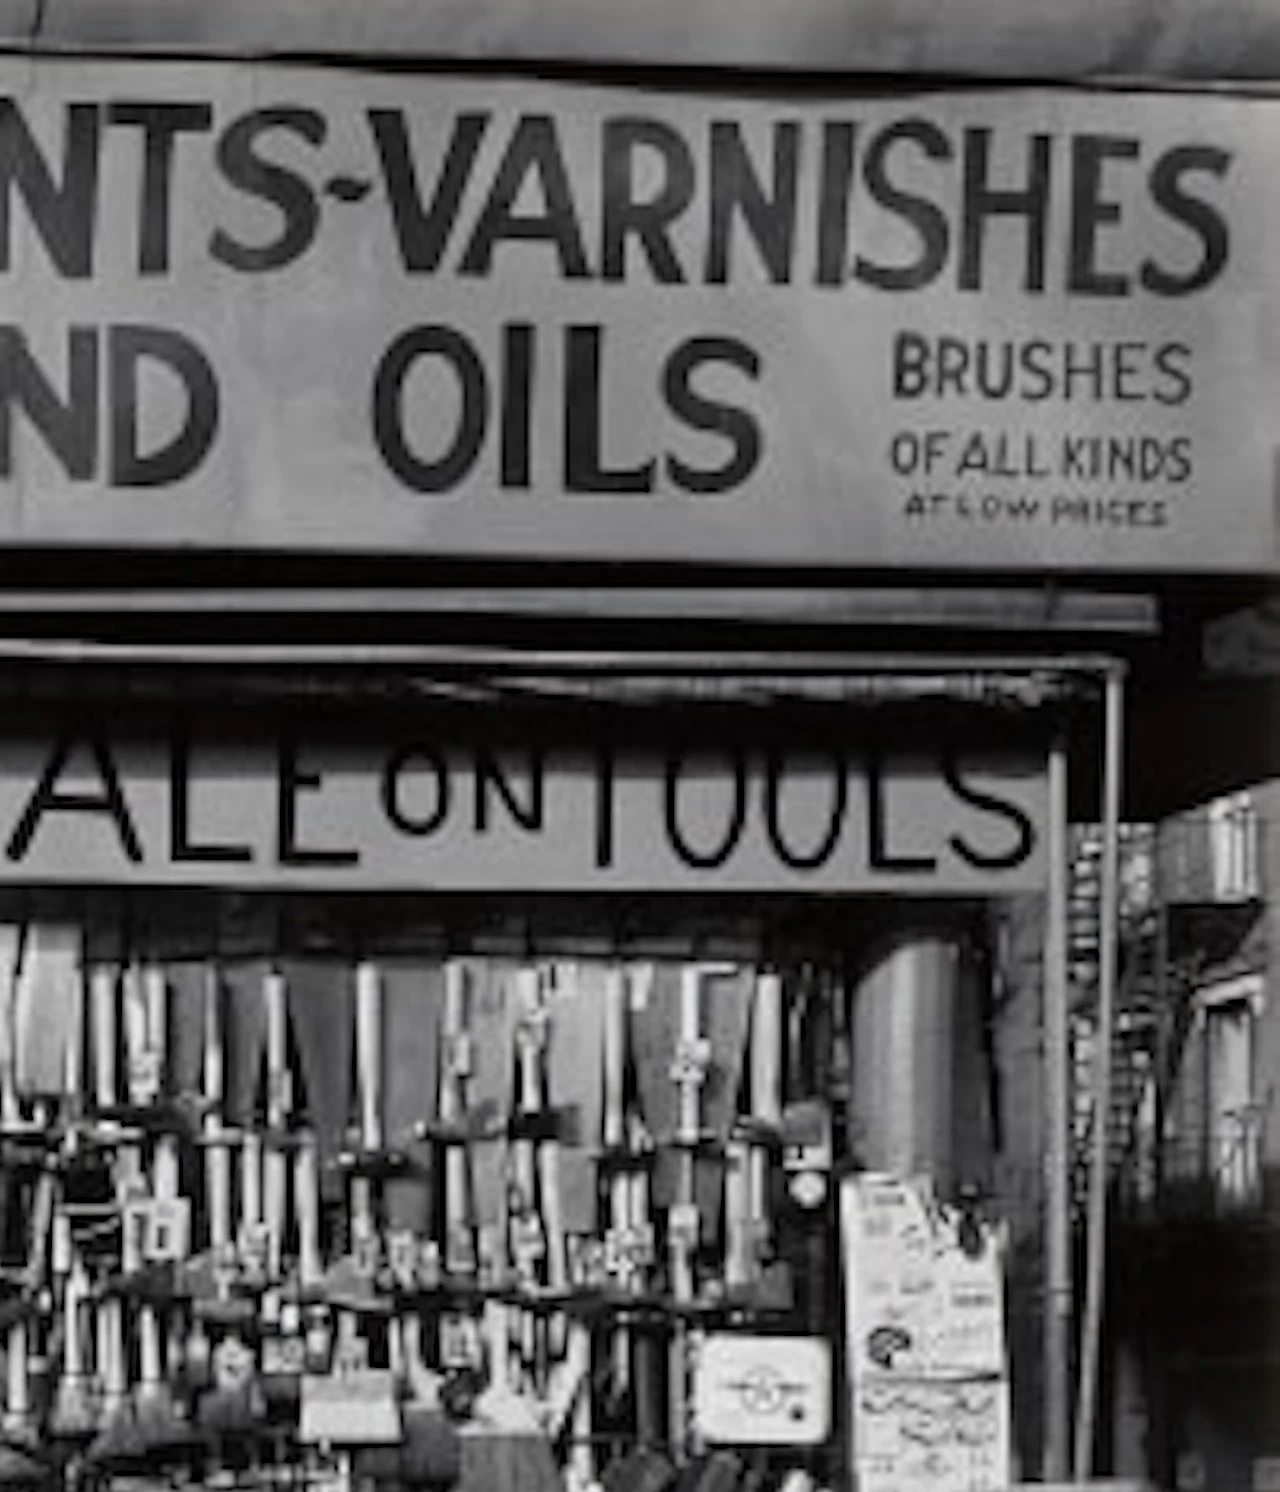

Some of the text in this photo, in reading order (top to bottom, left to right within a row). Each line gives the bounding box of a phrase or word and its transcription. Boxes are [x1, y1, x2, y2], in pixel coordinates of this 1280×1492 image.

[371, 322, 764, 496] OILS
[892, 329, 1193, 405] BRUSHES
[890, 430, 1193, 483] OF ALL KINDS
[378, 742, 546, 838] ON
[558, 718, 1037, 870] TOOLS
